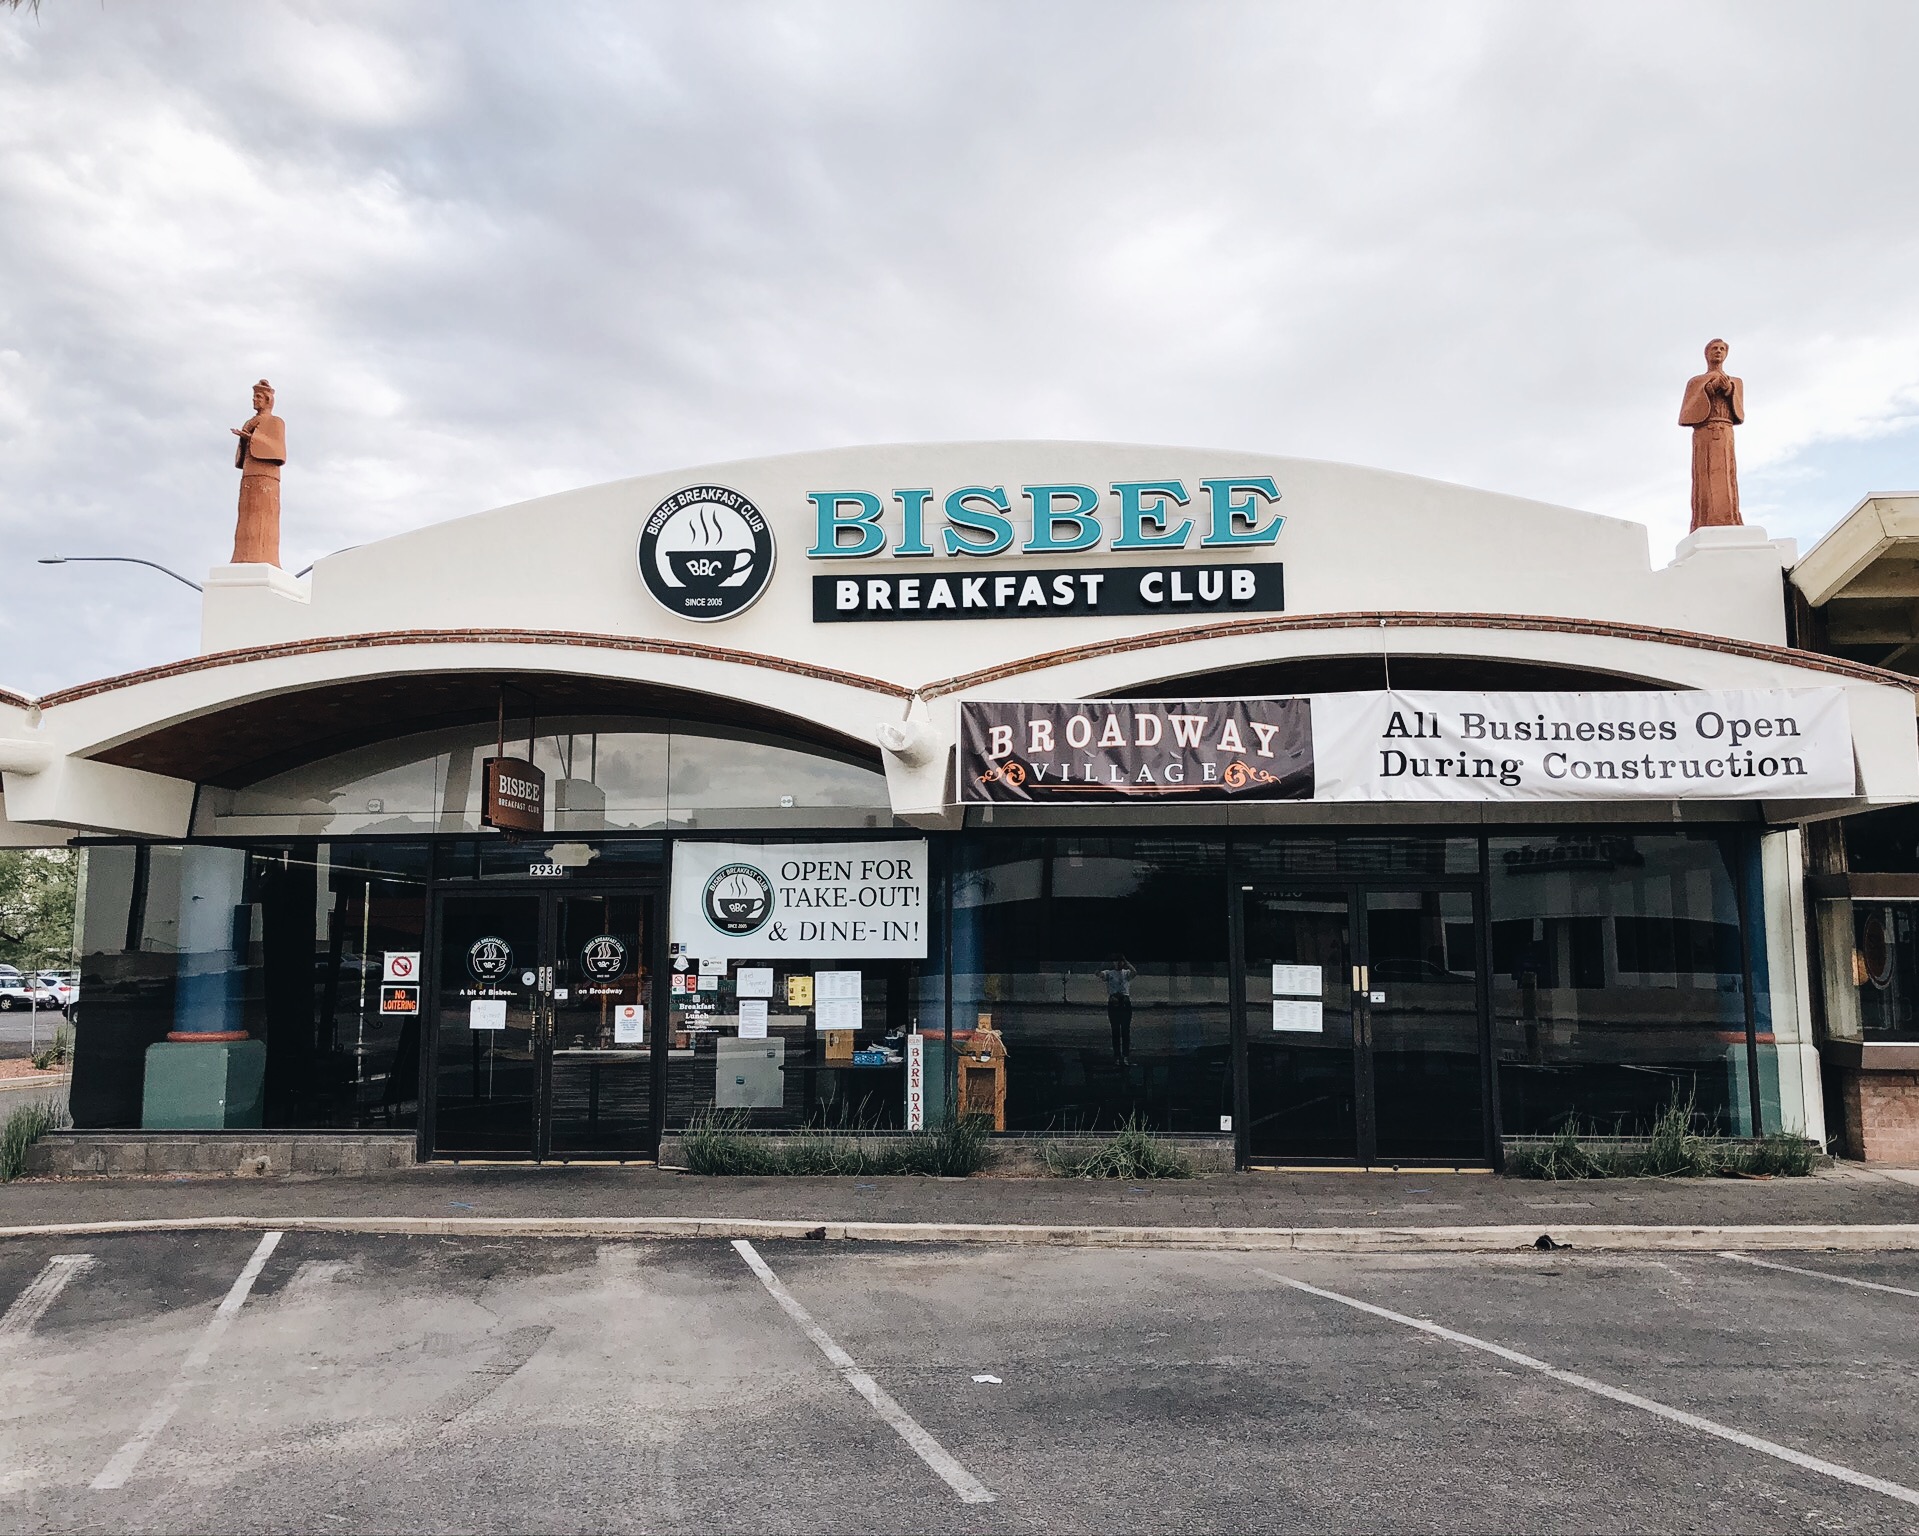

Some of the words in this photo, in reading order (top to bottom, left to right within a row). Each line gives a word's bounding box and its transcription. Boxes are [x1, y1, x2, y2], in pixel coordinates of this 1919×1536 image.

[646, 499, 679, 536] BISBEE
[677, 488, 743, 509] BREAKFAST
[741, 504, 764, 533] CLUB
[806, 476, 1288, 558] BISBEE
[686, 559, 722, 576] BBC
[835, 573, 1106, 612] BREAKFAST
[1139, 568, 1257, 605] CLUB
[685, 598, 706, 607] SINCE
[707, 598, 723, 607] 2005
[988, 713, 1280, 761] BROADWAY
[1382, 710, 1442, 739] All
[1460, 712, 1678, 741] Businesses
[1695, 710, 1801, 747] Open
[1031, 762, 1218, 783] VILLAGE
[1378, 750, 1524, 787] During
[1542, 751, 1808, 780] Construction
[498, 774, 540, 802] BISBEE
[498, 797, 526, 811] BREAKFAST
[528, 803, 539, 814] CLUB
[531, 864, 562, 875] 2936
[709, 872, 725, 892] BISBEE
[726, 867, 757, 878] BREAKFAST
[756, 876, 769, 892] CLUB
[781, 860, 853, 881] OPEN
[860, 859, 913, 880] FOR
[728, 902, 747, 913] BBC
[780, 886, 920, 908] TAKE-OUT!
[768, 920, 789, 941] &
[800, 920, 919, 941] DINE-IN!
[394, 990, 406, 999] NO
[590, 988, 623, 996] Broadway
[383, 1000, 416, 1010] LOITERING
[911, 1047, 920, 1088] BARN
